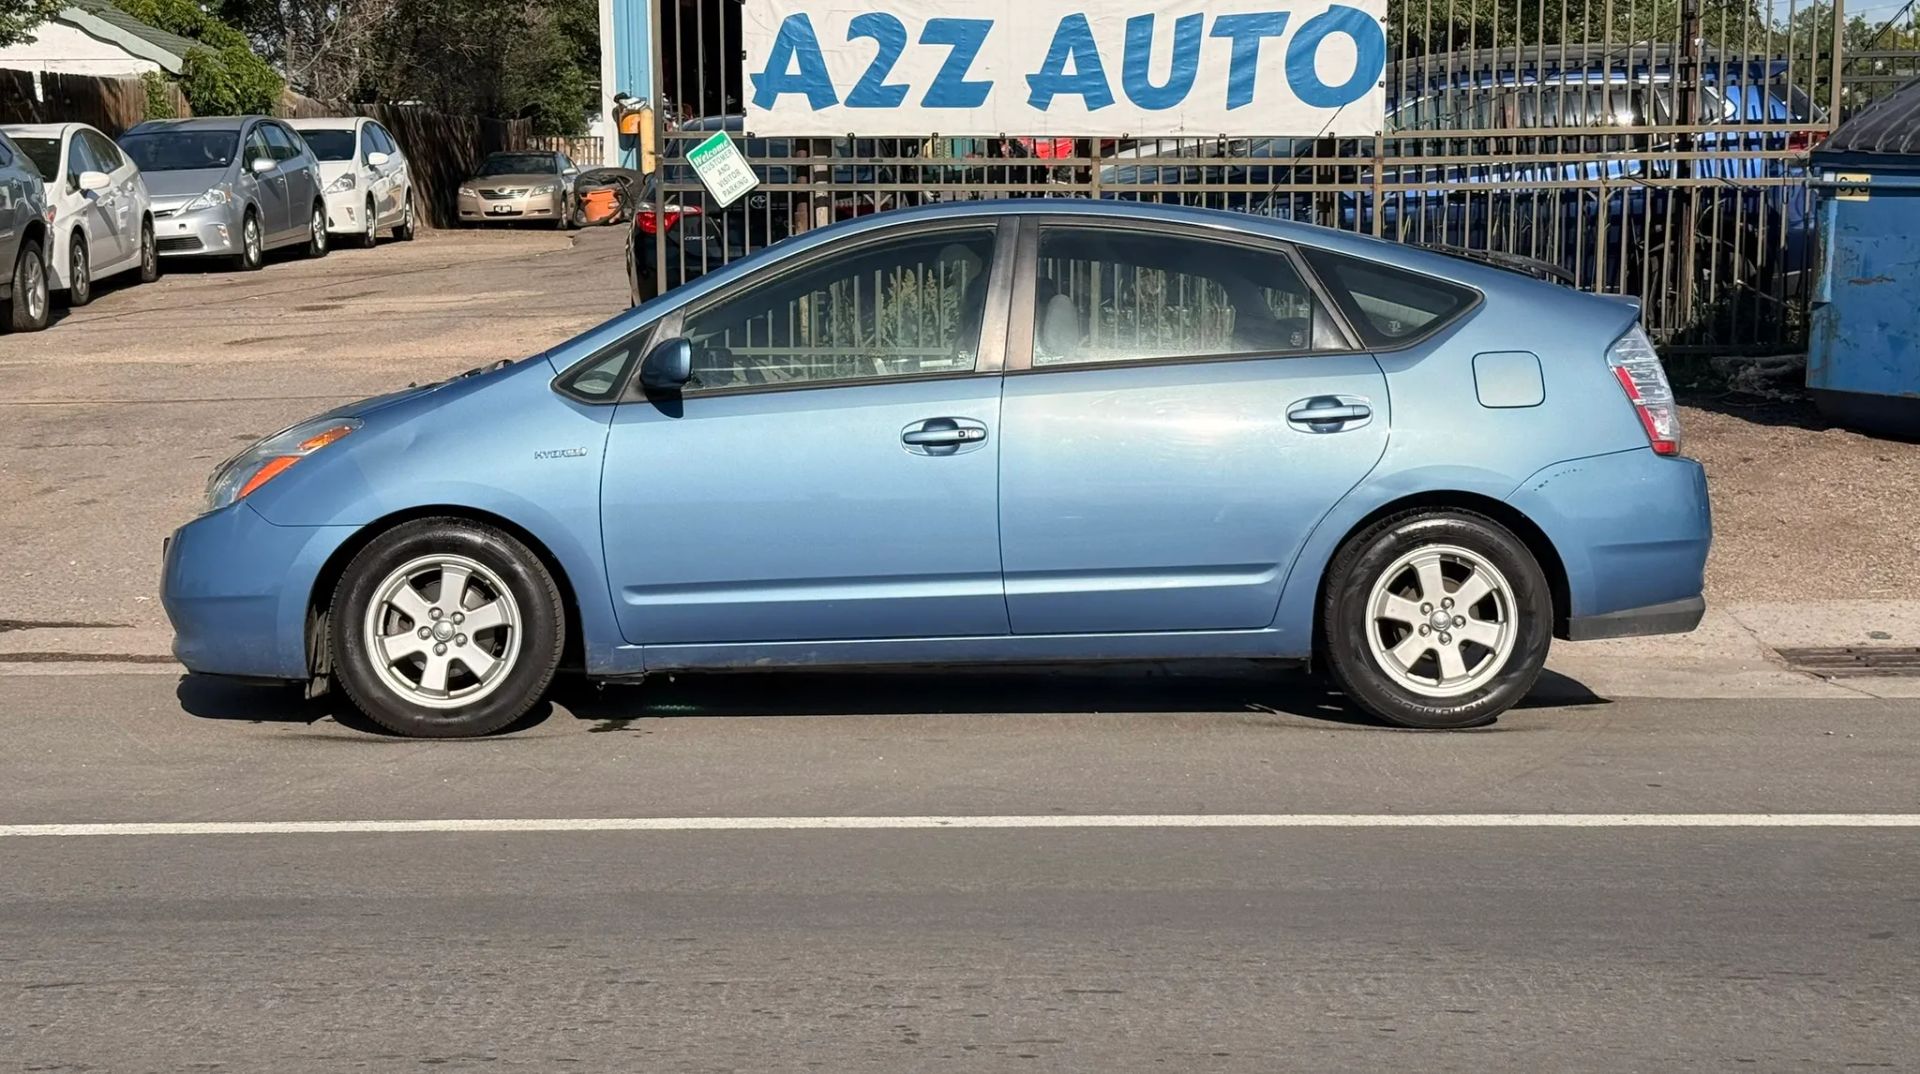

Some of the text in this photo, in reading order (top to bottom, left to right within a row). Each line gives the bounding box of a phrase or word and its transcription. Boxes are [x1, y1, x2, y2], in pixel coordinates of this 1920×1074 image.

[750, 3, 1386, 111] A2Z AUTO
[693, 139, 729, 166] Welcome
[702, 148, 734, 174] CUSTOMER
[717, 163, 731, 177] AND
[717, 168, 742, 189] VISITOR
[722, 176, 749, 198] PARKING
